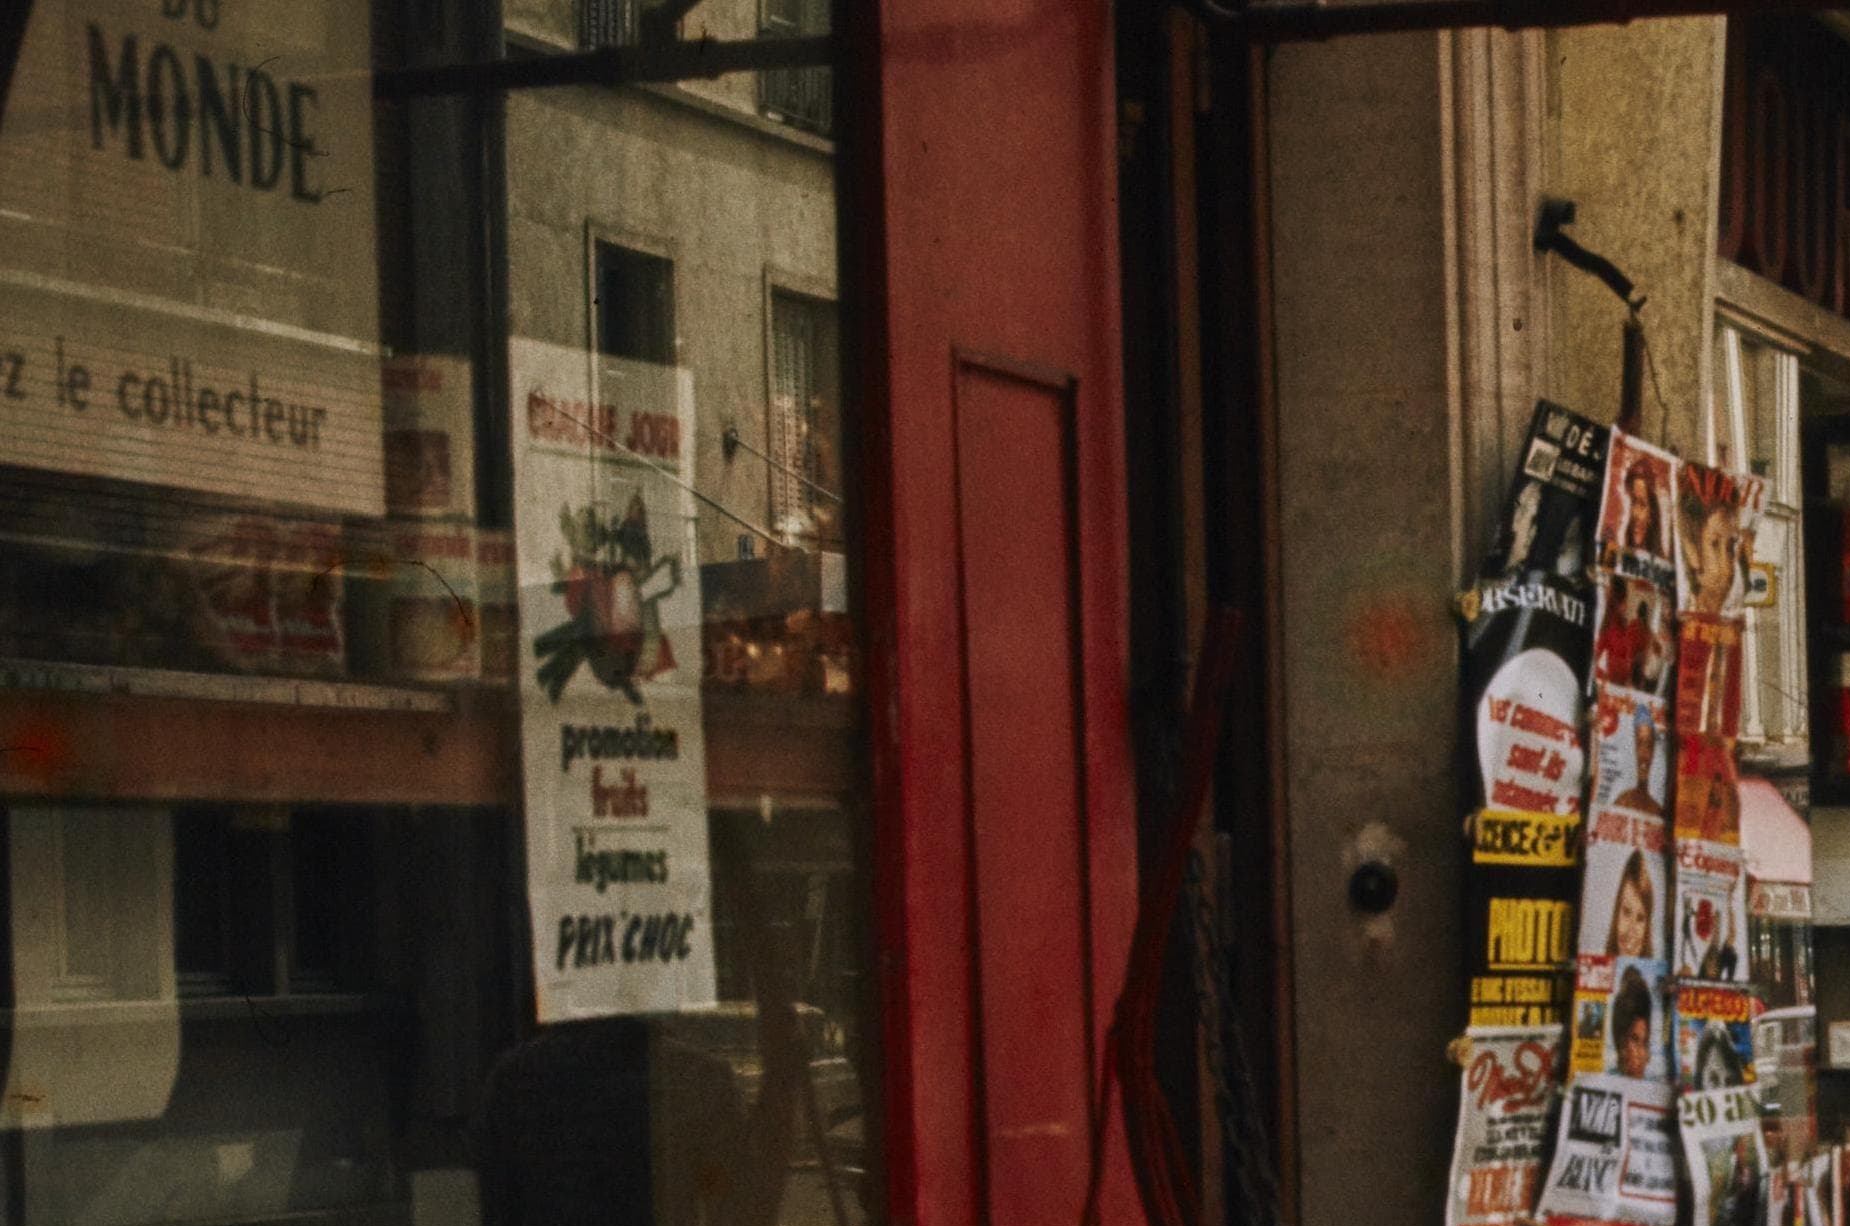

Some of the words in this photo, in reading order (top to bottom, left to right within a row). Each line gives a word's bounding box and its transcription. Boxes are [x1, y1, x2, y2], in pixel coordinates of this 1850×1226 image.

[87, 23, 322, 204] MONDE
[56, 336, 92, 412] le
[116, 354, 328, 452] collecteur
[561, 711, 679, 773] promotion
[592, 766, 649, 818] fruits
[575, 827, 669, 893] légumes
[557, 914, 617, 970] PRIX
